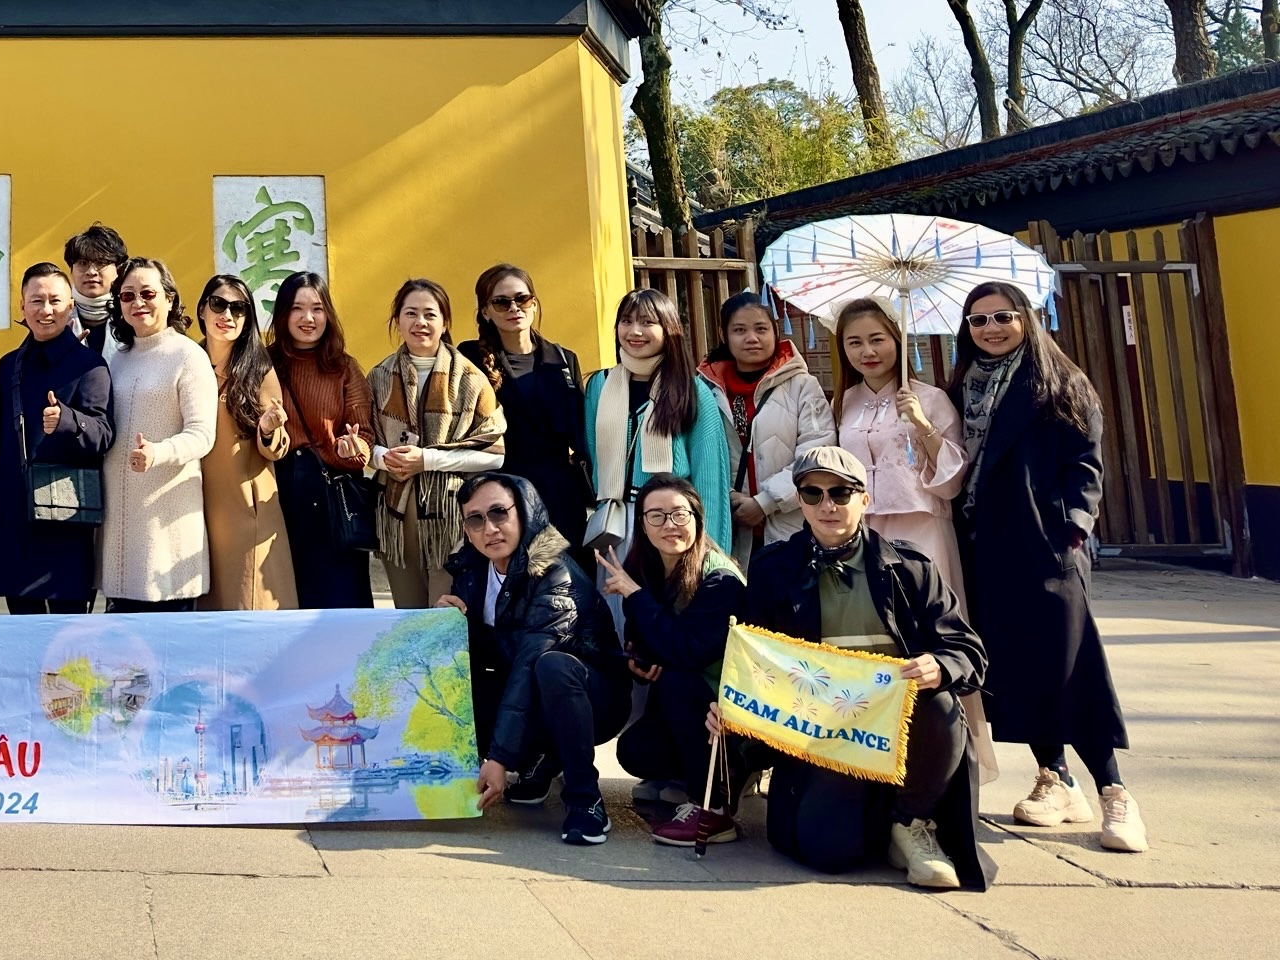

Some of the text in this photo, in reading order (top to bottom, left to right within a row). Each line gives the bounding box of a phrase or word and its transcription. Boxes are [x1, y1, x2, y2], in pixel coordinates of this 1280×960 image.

[875, 673, 892, 685] 39
[723, 685, 891, 752] TEAM ALLIANCE
